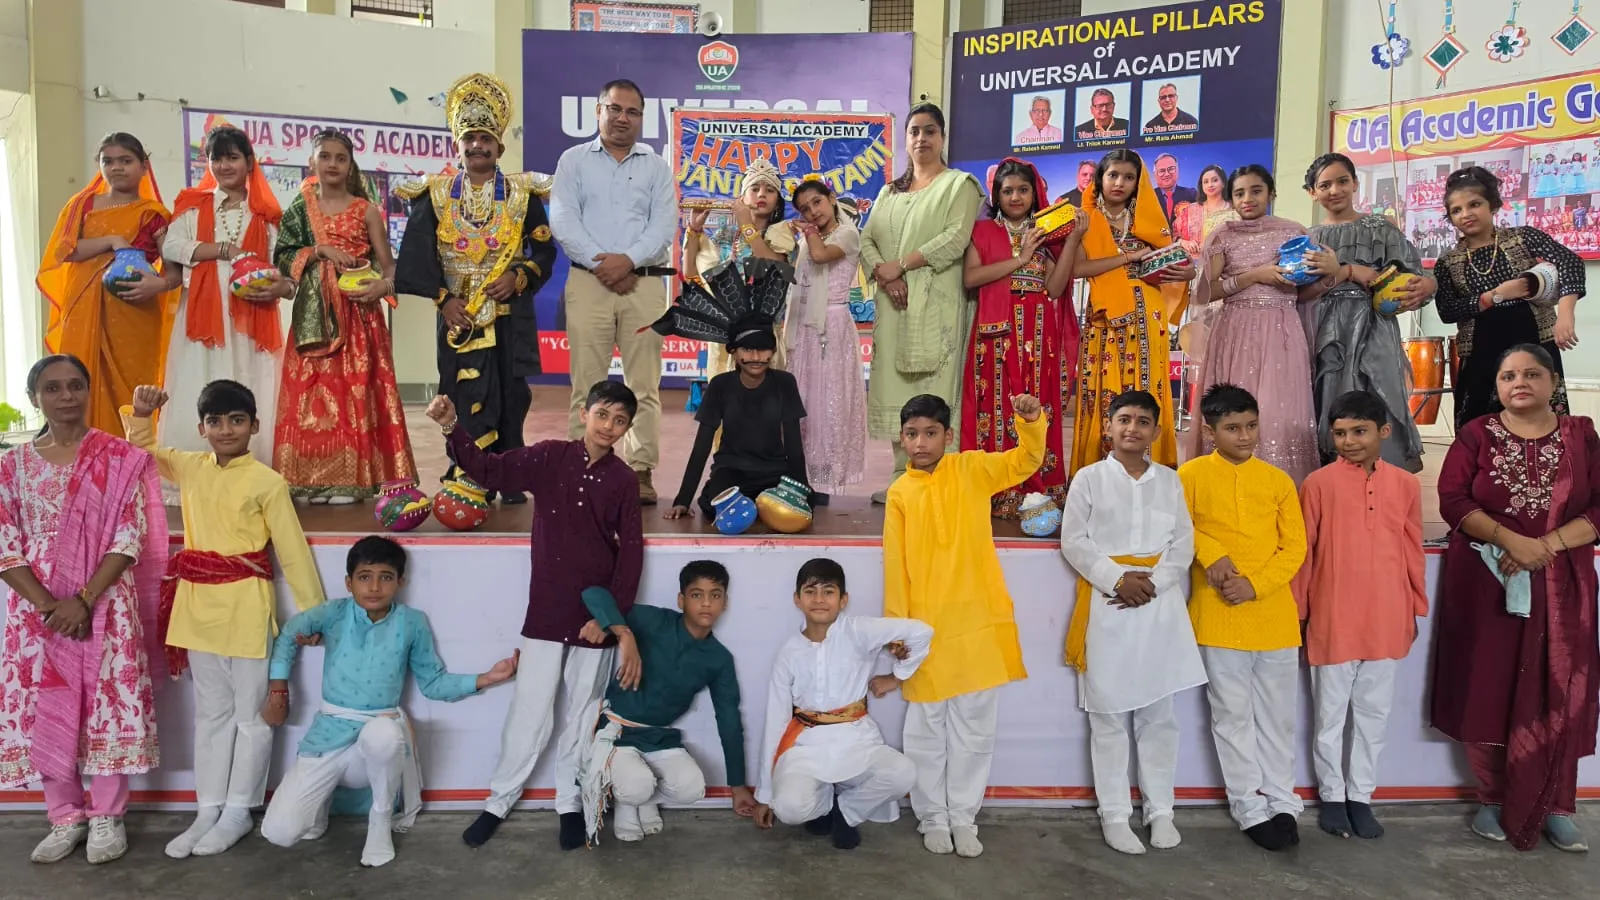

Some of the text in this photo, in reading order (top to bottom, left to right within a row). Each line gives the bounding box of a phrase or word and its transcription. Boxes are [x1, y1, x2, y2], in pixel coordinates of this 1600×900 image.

[963, 1, 1265, 56] INSPIRATIONAL PILLARS
[707, 65, 728, 76] UA
[980, 45, 1241, 92] UNIVERSAL ACADEMY
[1093, 42, 1115, 59] of
[243, 119, 274, 146] UA
[373, 130, 461, 158] ACADEM
[701, 123, 865, 137] UNIVERSAL ACADEMY
[1348, 115, 1389, 151] UA
[1401, 91, 1555, 148] Academic
[691, 133, 823, 174] HAPPY
